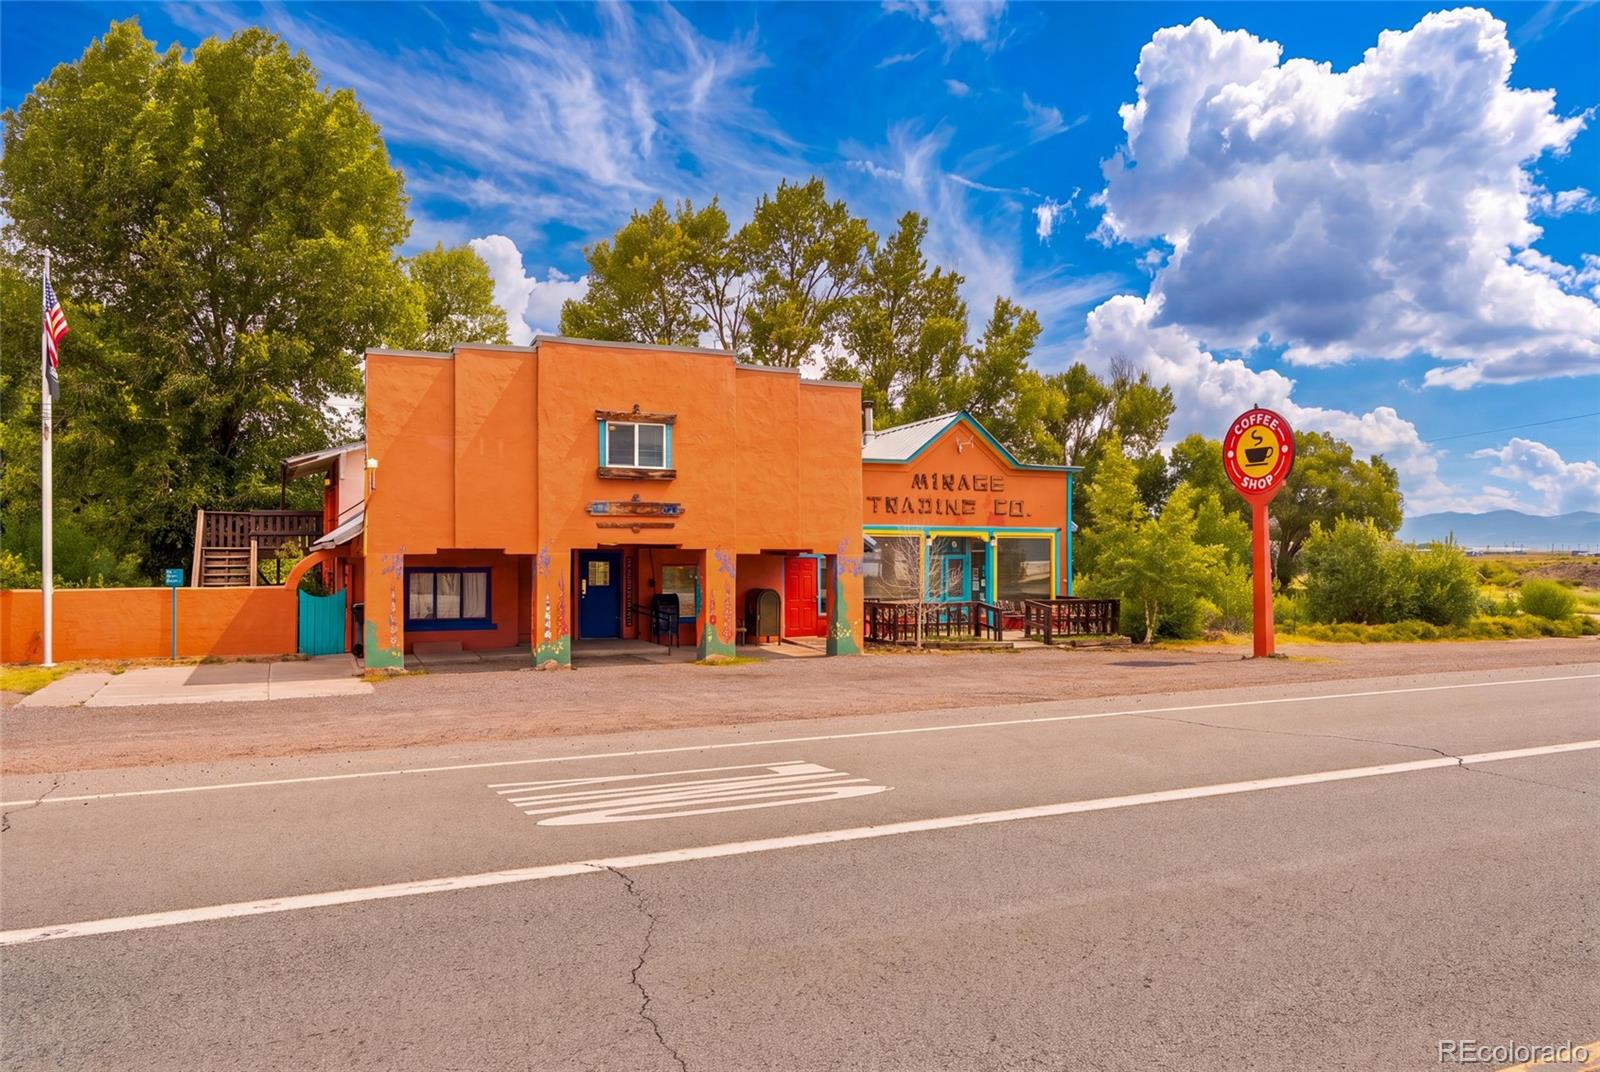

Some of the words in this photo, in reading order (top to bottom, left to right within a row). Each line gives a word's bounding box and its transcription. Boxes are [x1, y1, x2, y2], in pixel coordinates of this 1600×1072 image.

[1234, 413, 1279, 435] COFFEE
[911, 472, 1005, 493] MIRAGE
[1241, 474, 1274, 490] SHOP
[866, 496, 977, 517] TRADING
[994, 499, 1033, 518] CO.
[487, 760, 896, 826] ONLY
